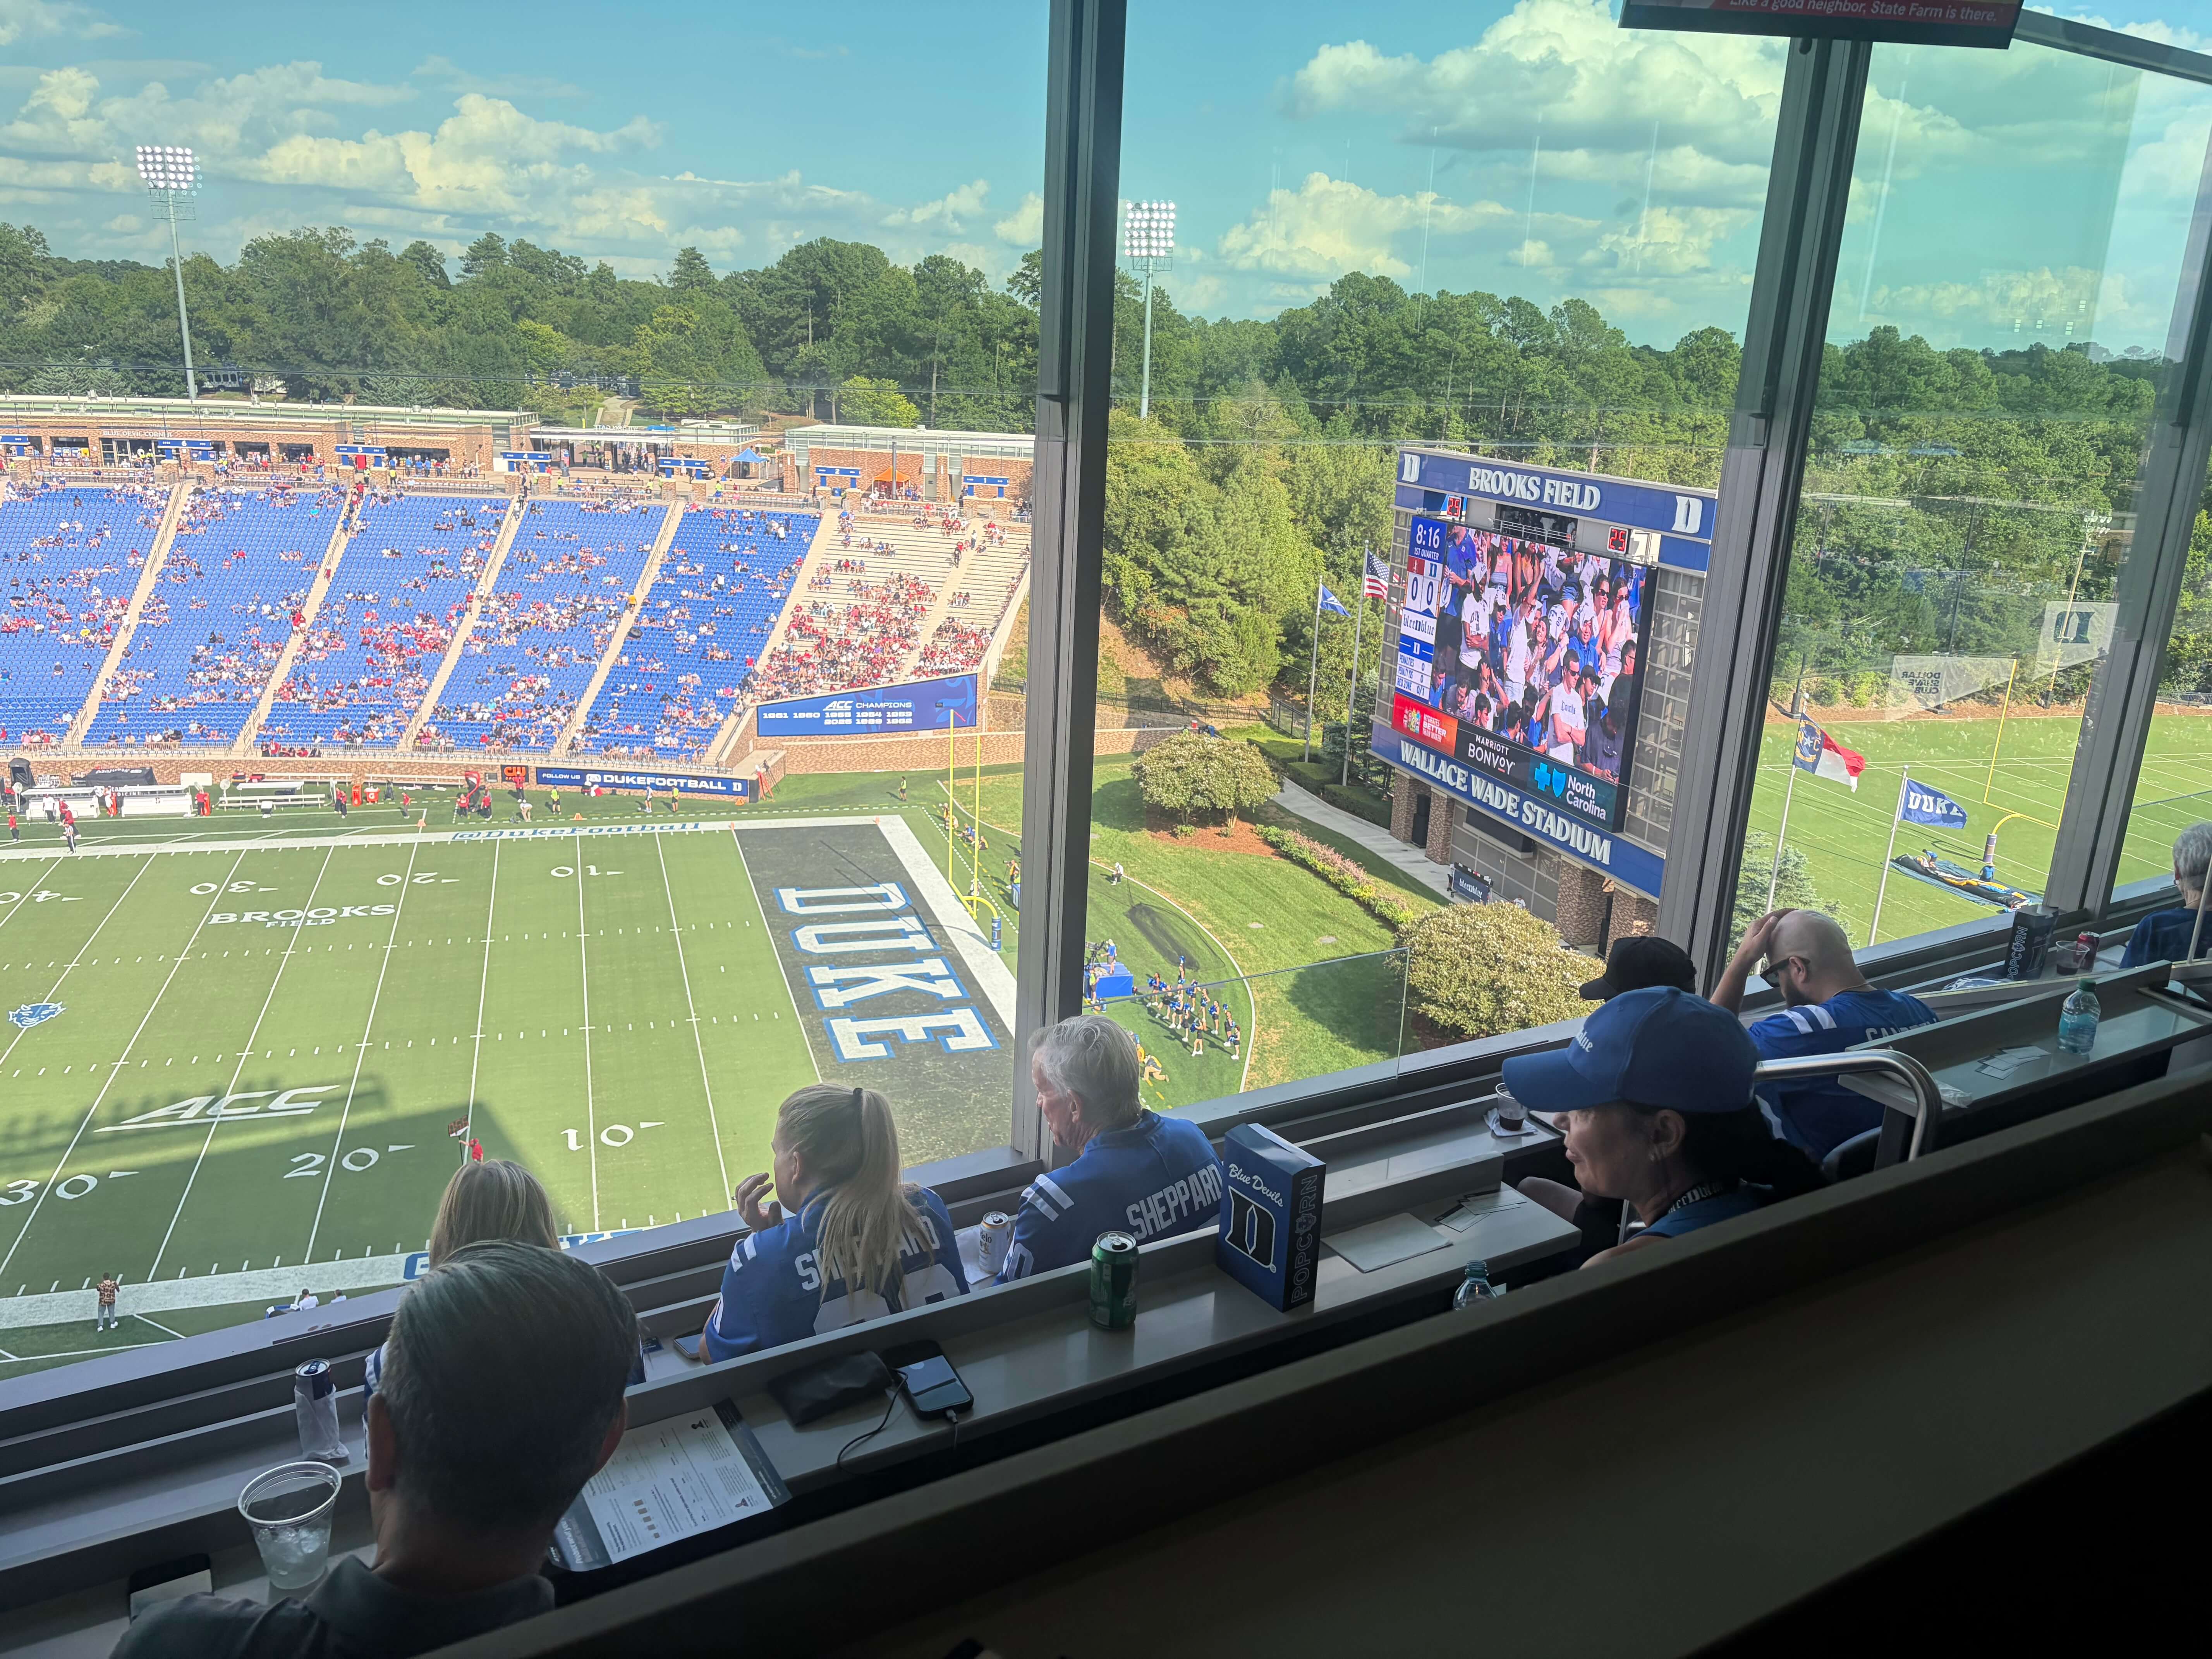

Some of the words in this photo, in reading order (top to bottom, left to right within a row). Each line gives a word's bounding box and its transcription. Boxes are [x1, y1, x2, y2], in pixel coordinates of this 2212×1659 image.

[1771, 0, 1804, 10] good
[1807, 0, 1866, 15] neighbor,
[1871, 0, 1906, 15] State
[1908, 2, 1943, 18] Farm
[1946, 5, 1957, 19] is
[1960, 7, 1997, 22] there.
[1468, 467, 1541, 501] BROOKS
[1543, 479, 1601, 510] FIELD
[1448, 497, 1461, 517] 25
[1416, 524, 1440, 548] 8:16
[1609, 528, 1626, 552] 25
[1421, 550, 1439, 560] QUARTER
[1411, 577, 1418, 601] 0
[1427, 581, 1434, 605] 0
[1398, 666, 1408, 677] PENALTY
[1420, 675, 1424, 683] 0
[1400, 654, 1414, 667] PENALTIES
[1422, 663, 1425, 671] 0
[1403, 680, 1412, 691] ZONE
[823, 701, 854, 711] ACC
[1423, 714, 1440, 726] HYDRATES
[1423, 722, 1446, 737] BETTER
[1422, 729, 1431, 738] THAN
[1431, 732, 1442, 743] WATER
[1475, 735, 1509, 756] MARRIOTT
[1468, 743, 1515, 775] BONVOY
[1568, 775, 1595, 800] North
[1400, 740, 1468, 792] WALLACE
[1471, 772, 1520, 818] WADE
[1522, 800, 1612, 866] STADIUM
[1566, 790, 1607, 820] Carolina
[452, 822, 700, 841] @DukeFootball
[207, 904, 396, 926] BROOKS
[265, 918, 336, 928] FIELD
[772, 881, 1001, 1063] DUKE
[116, 1085, 340, 1126] ACC
[561, 1124, 634, 1152] 10
[283, 1147, 379, 1179] 20
[1229, 1163, 1251, 1185] Blue
[1252, 1175, 1283, 1207] Devils
[1126, 1163, 1223, 1240] SHEPPARD
